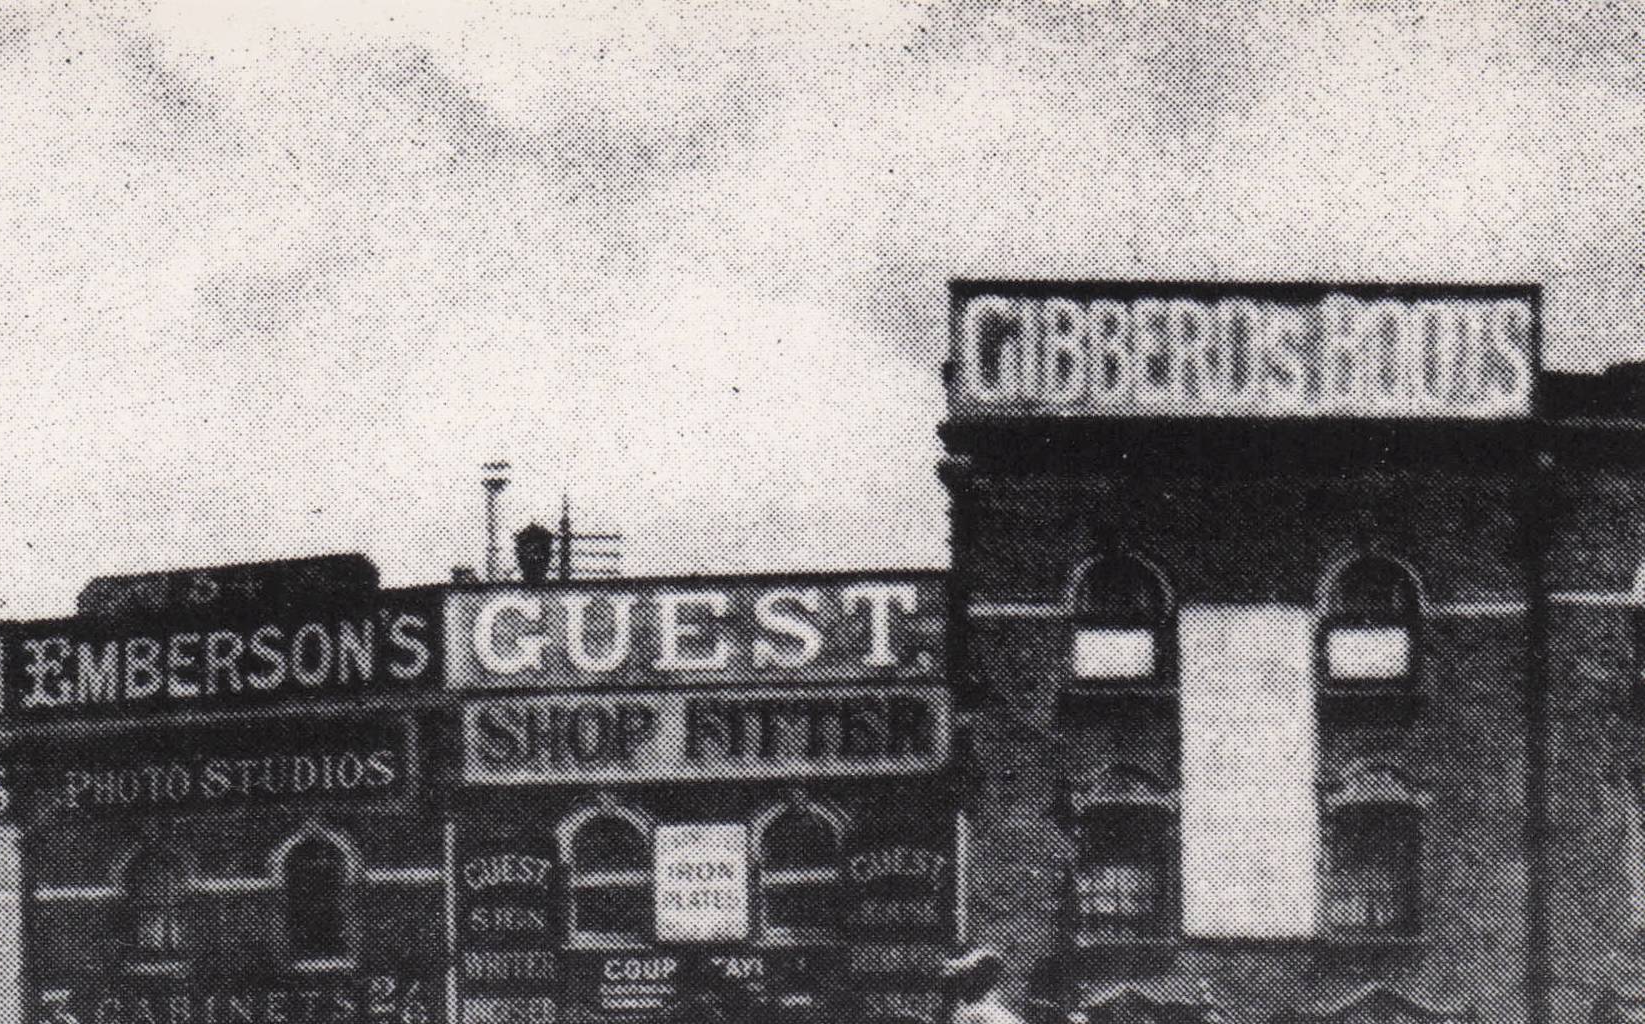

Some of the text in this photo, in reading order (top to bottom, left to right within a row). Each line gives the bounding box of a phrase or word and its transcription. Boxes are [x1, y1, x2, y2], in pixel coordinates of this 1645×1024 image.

[1319, 294, 1529, 406] BOOTS
[24, 613, 433, 708] EMBERSON'S
[474, 701, 654, 764] SHOP
[63, 749, 398, 810] PHOTO STUDIOS
[460, 852, 554, 893] GUEST
[467, 904, 548, 934] SIGN
